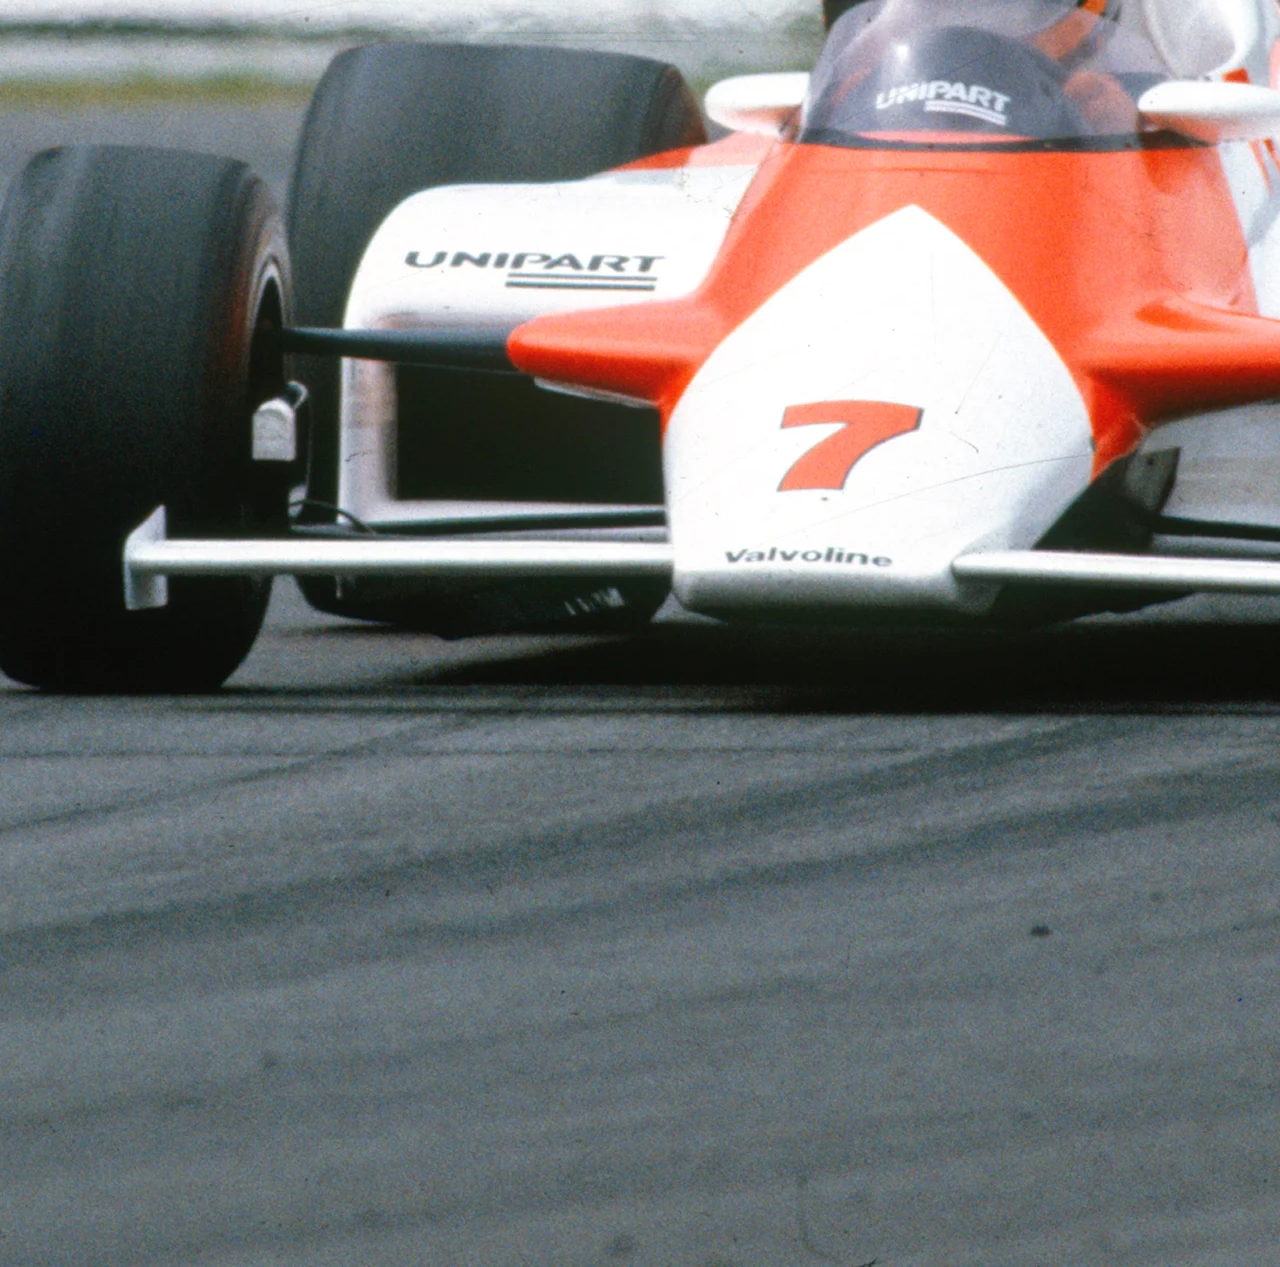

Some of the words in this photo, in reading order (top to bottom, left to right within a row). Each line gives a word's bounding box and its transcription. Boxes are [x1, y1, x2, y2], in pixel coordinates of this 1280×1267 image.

[875, 80, 1011, 112] UNIPART
[404, 250, 666, 273] UNIPART
[777, 399, 924, 492] 7
[724, 546, 893, 568] Valvoline
